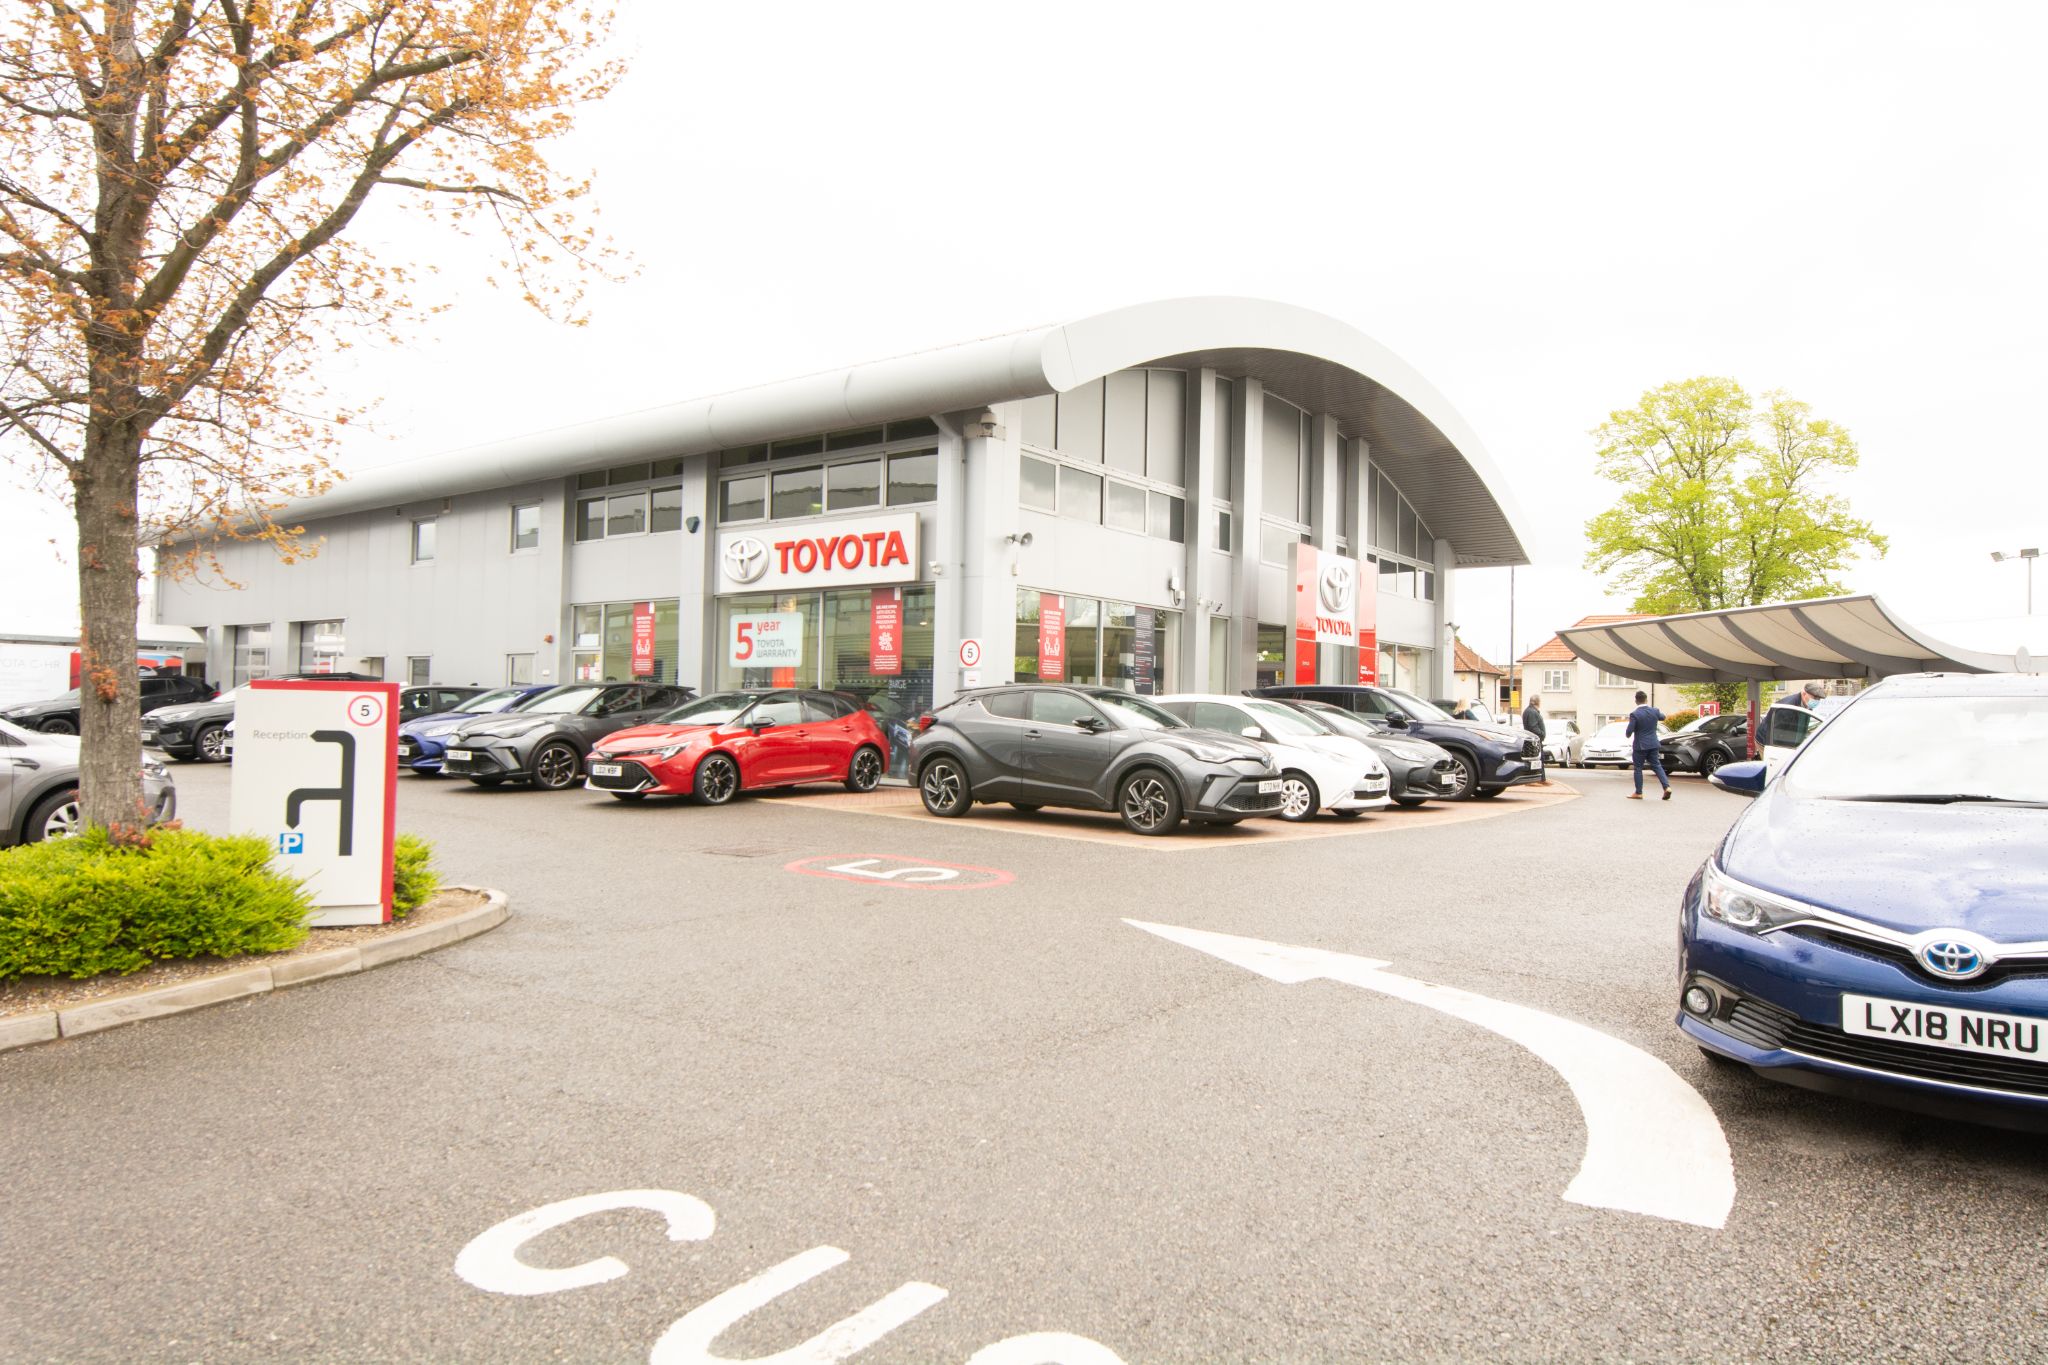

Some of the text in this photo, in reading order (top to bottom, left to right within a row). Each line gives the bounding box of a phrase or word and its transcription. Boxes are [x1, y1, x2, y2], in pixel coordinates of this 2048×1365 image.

[774, 531, 909, 574] TOYOTA
[1316, 616, 1352, 637] TOYOTA
[735, 621, 781, 660] 5 year
[757, 639, 785, 648] TOYOTA
[757, 649, 797, 658] WARRANTY
[967, 648, 973, 658] 5
[360, 704, 370, 716] 5
[253, 729, 308, 741] Reception
[283, 834, 301, 853] P
[826, 859, 960, 881] 5
[1866, 1002, 2039, 1054] LX18 NRU
[454, 1189, 1125, 1365] CU
